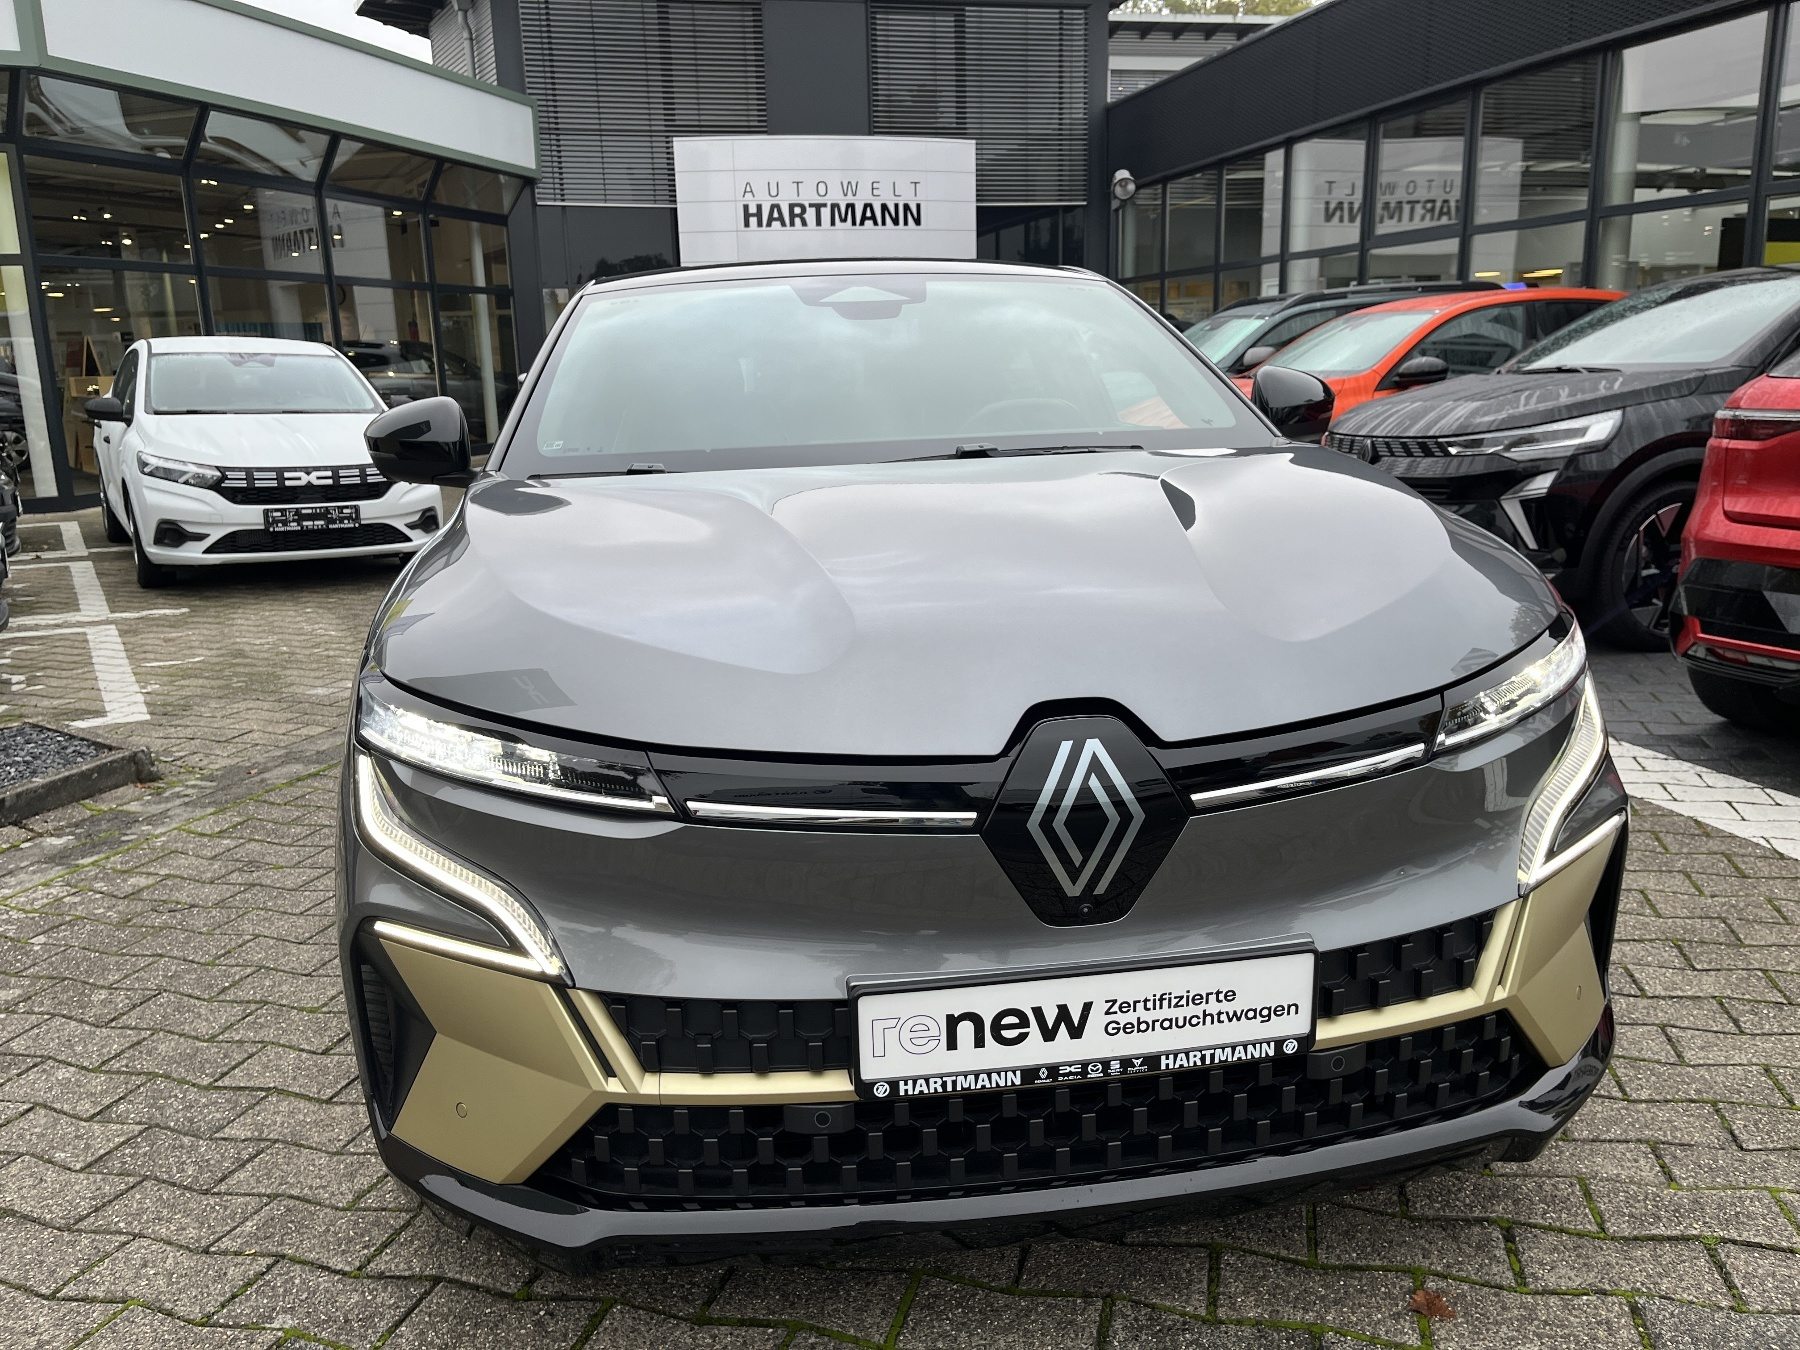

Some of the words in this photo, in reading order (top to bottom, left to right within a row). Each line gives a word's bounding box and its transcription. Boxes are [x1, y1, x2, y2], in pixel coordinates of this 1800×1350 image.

[742, 181, 921, 198] AUTOWELT
[743, 202, 922, 228] HARTMANN
[1104, 988, 1237, 1016] Zertifizierte
[871, 1001, 1094, 1057] renew
[1104, 1002, 1299, 1036] Gebrauchtwagen
[1160, 1042, 1275, 1070] HARTMANN
[899, 1070, 1022, 1096] HARTMANN
